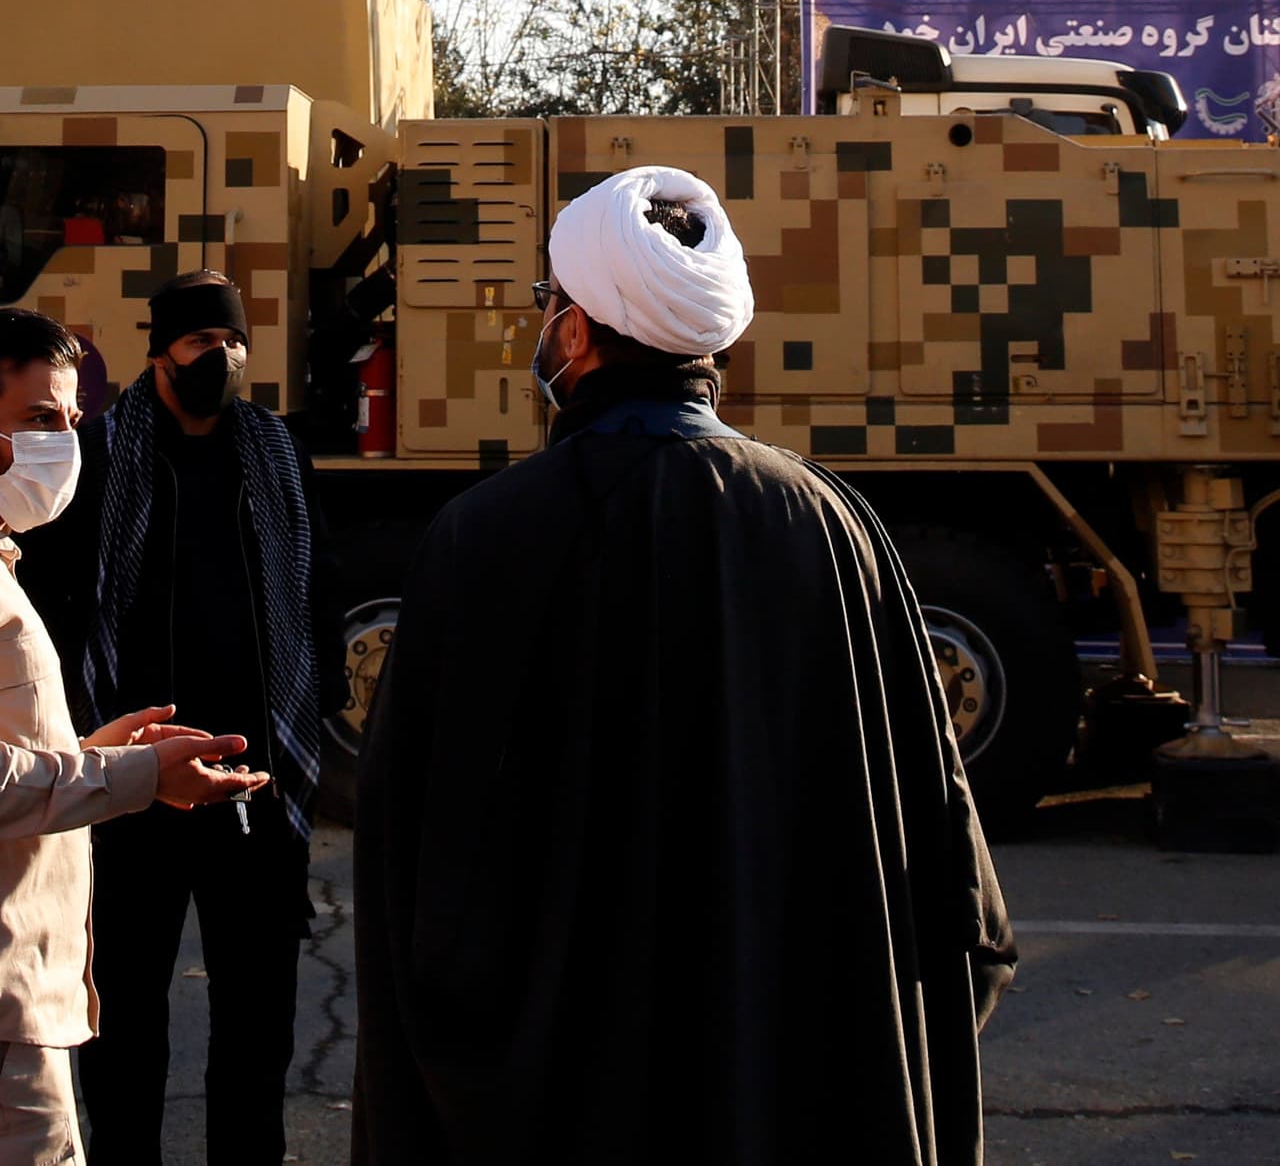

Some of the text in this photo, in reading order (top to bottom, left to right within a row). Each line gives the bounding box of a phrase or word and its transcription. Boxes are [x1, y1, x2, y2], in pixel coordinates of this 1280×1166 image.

[949, 14, 1027, 55] ایران
[1035, 19, 1133, 56] صنعتی
[1141, 15, 1215, 56] گروه
